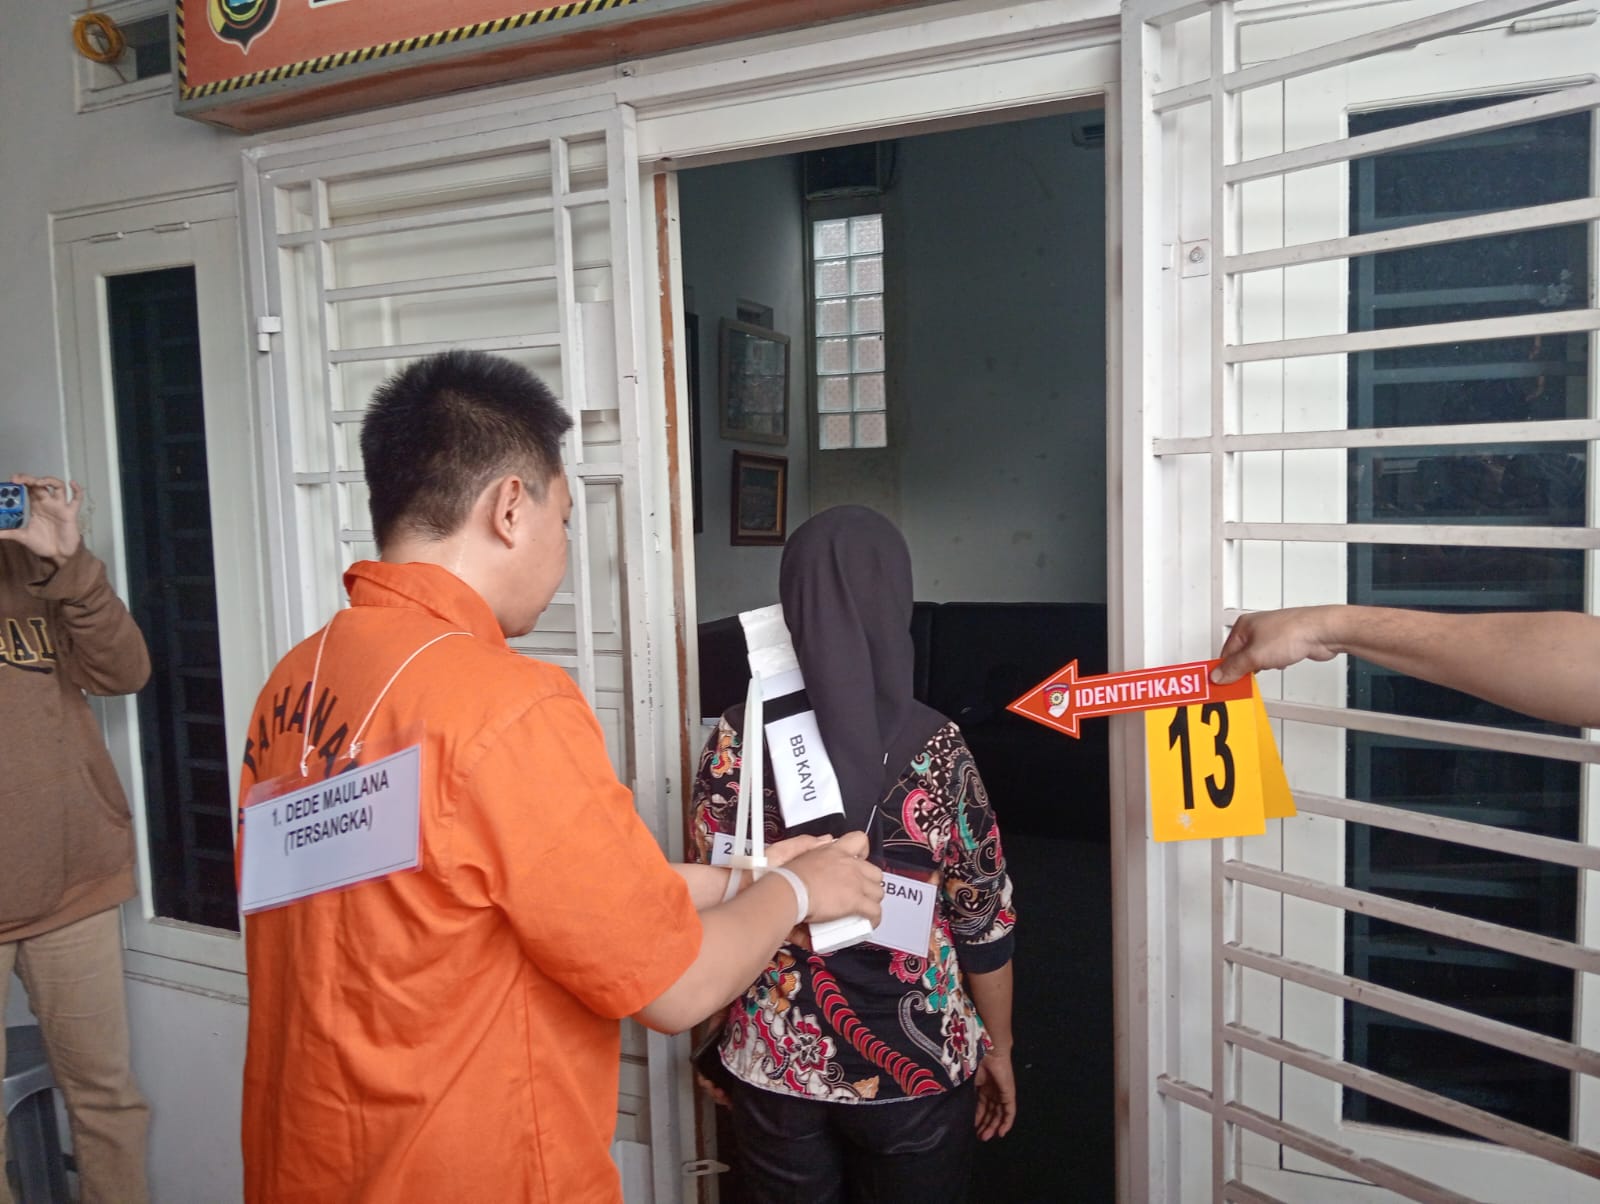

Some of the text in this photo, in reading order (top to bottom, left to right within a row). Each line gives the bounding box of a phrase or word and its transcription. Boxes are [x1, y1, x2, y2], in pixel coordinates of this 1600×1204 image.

[1075, 674, 1200, 707] IDENTIFIKASI
[789, 734, 817, 801] BB KAYU
[1168, 701, 1236, 810] 13
[272, 808, 282, 827] 1.
[286, 794, 320, 822] DEDE
[323, 770, 389, 810] MAULANA
[284, 805, 373, 857] (TERSANGKA)
